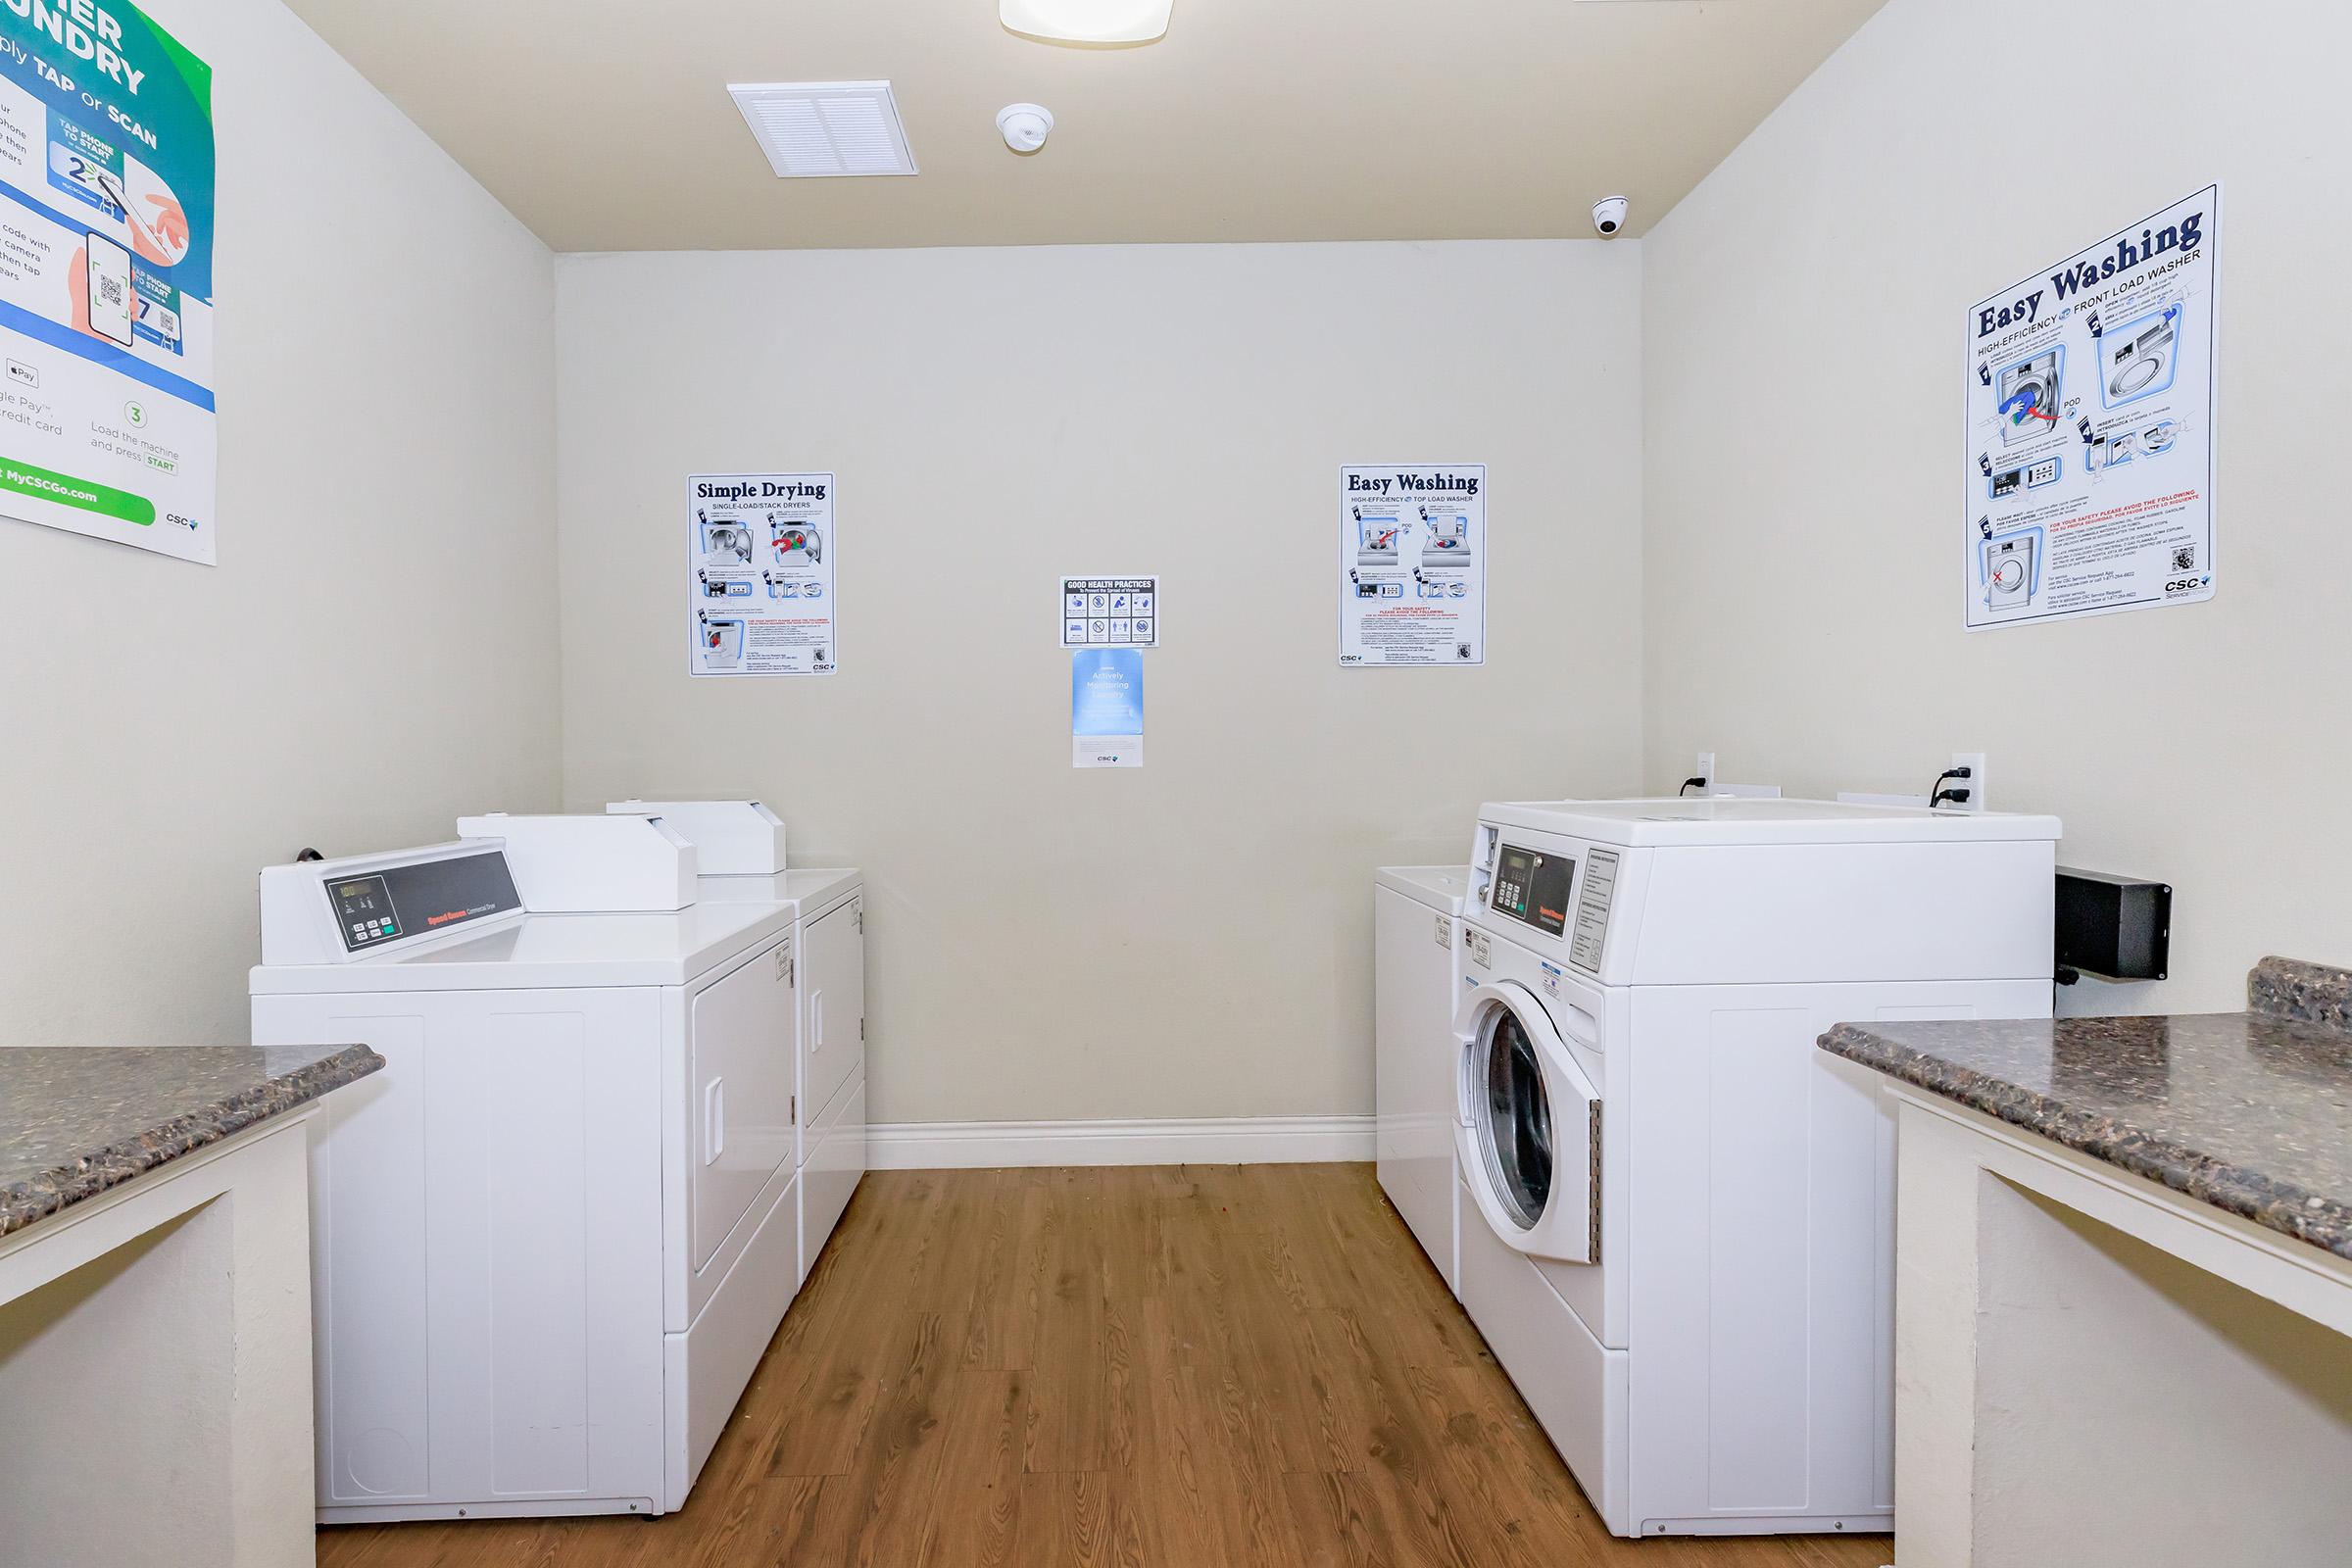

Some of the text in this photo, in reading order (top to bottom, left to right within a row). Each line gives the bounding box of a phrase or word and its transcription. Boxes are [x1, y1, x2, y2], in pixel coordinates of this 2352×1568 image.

[58, 0, 122, 52] ER
[32, 56, 75, 92] TAP
[81, 92, 103, 111] or
[108, 104, 158, 150] SCAN
[6, 135, 27, 155] then
[59, 118, 79, 134] TAP
[79, 129, 116, 156] PHONE
[62, 127, 77, 142] TO
[79, 136, 112, 162] START
[69, 156, 86, 184] 2
[2, 223, 51, 253] code with
[5, 238, 41, 264] camera
[24, 264, 41, 277] tap
[1978, 289, 2044, 339] Easy
[2050, 211, 2204, 301] Washing
[137, 297, 151, 320] 7
[1977, 314, 2059, 358] HIGH-EFFICIENCY
[2074, 290, 2110, 315] FRONT
[2112, 274, 2145, 297] LOAD
[2147, 249, 2202, 281] WASHER
[18, 368, 35, 382] Pay
[131, 407, 141, 422] 3
[2064, 397, 2081, 409] POD
[0, 409, 63, 436] redit card
[90, 437, 174, 472] and press START
[91, 421, 179, 461] Load the machine
[6, 469, 98, 503] MyCSCGo.com
[697, 482, 827, 502] Simple Drying
[1348, 473, 1479, 495] Easy Washing
[783, 501, 811, 510] DRYERS
[2077, 514, 2099, 522] SAFETY
[2100, 507, 2122, 516] PLEASE
[2123, 502, 2142, 512] AVOID
[2157, 488, 2196, 503] FOLLOWING
[166, 513, 189, 527] CSC
[2165, 578, 2199, 592] CSC
